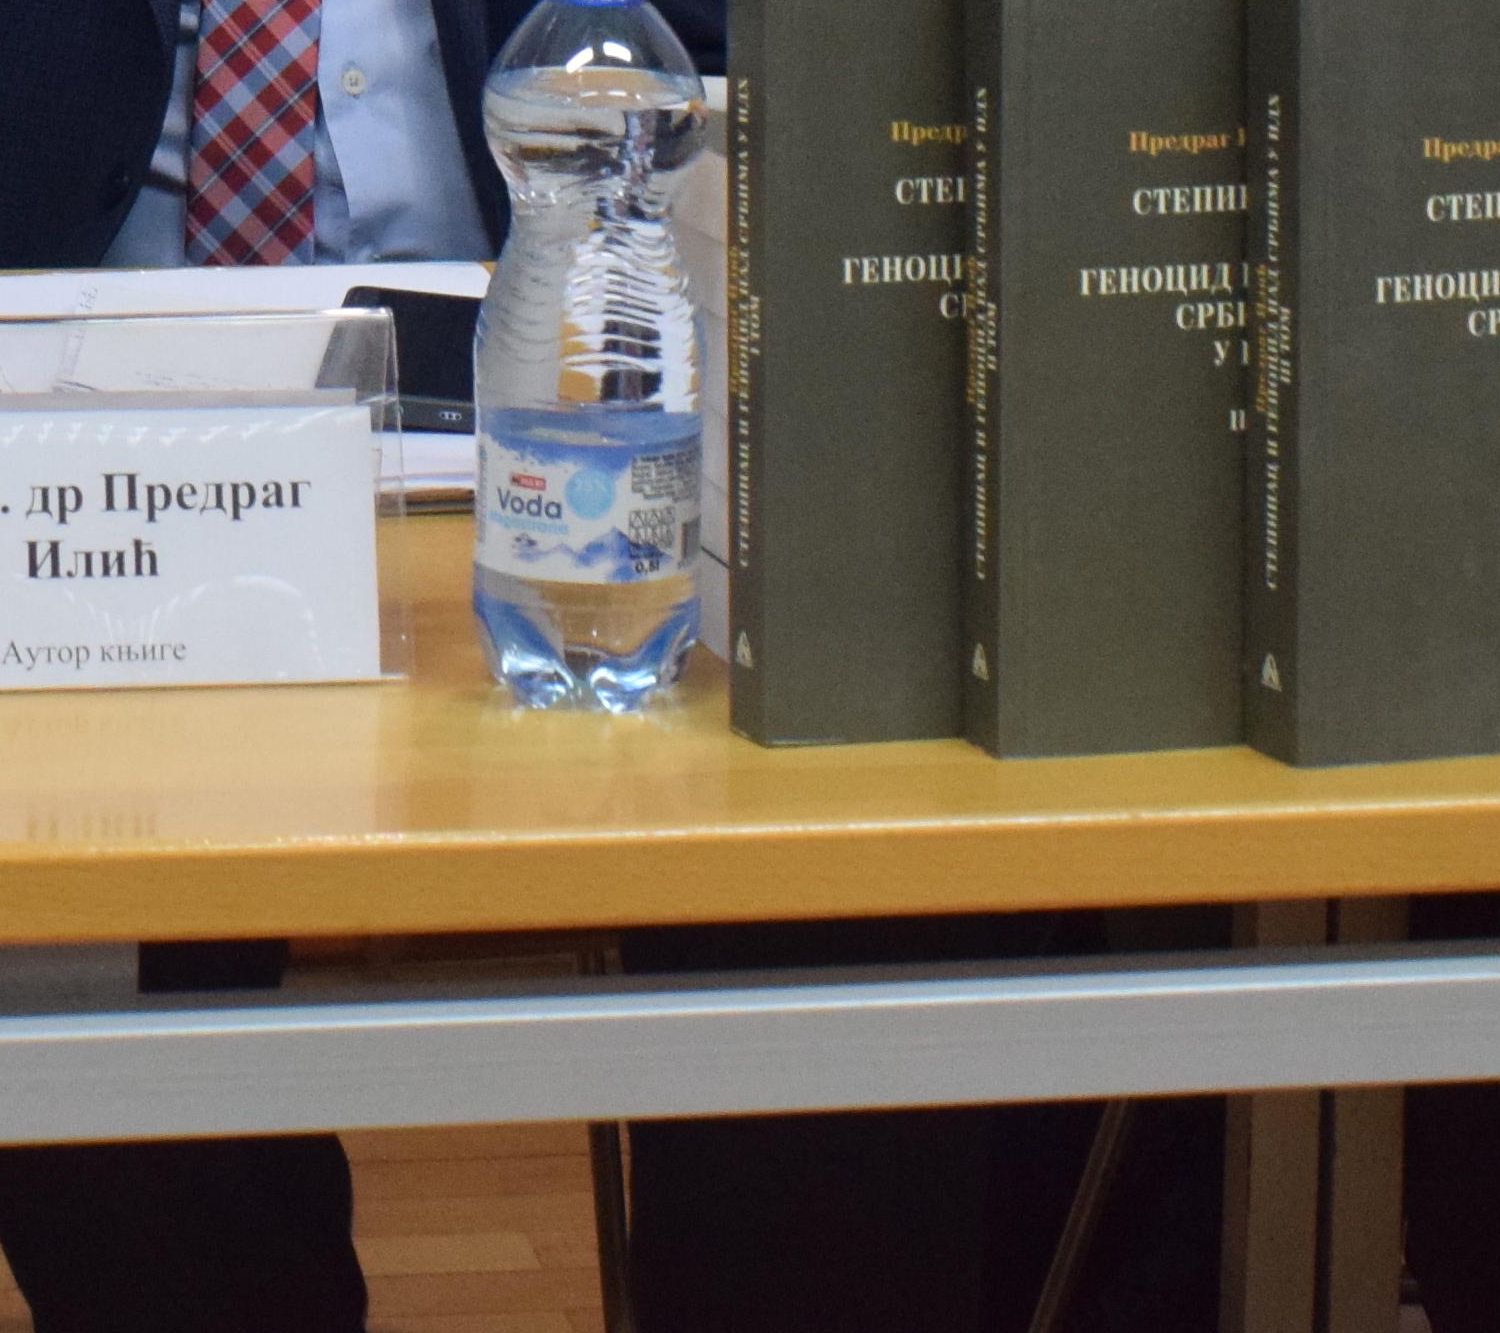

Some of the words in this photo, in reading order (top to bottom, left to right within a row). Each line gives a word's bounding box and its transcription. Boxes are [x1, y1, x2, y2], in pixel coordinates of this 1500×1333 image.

[1129, 131, 1230, 156] Предраг
[1080, 262, 1233, 297] ГЕНОЦИД
[26, 485, 83, 525] др
[104, 473, 310, 519] Предраг
[497, 485, 562, 520] Voda
[27, 539, 158, 579] Илић
[2, 640, 90, 671] Аутор
[100, 643, 186, 662] књиге
